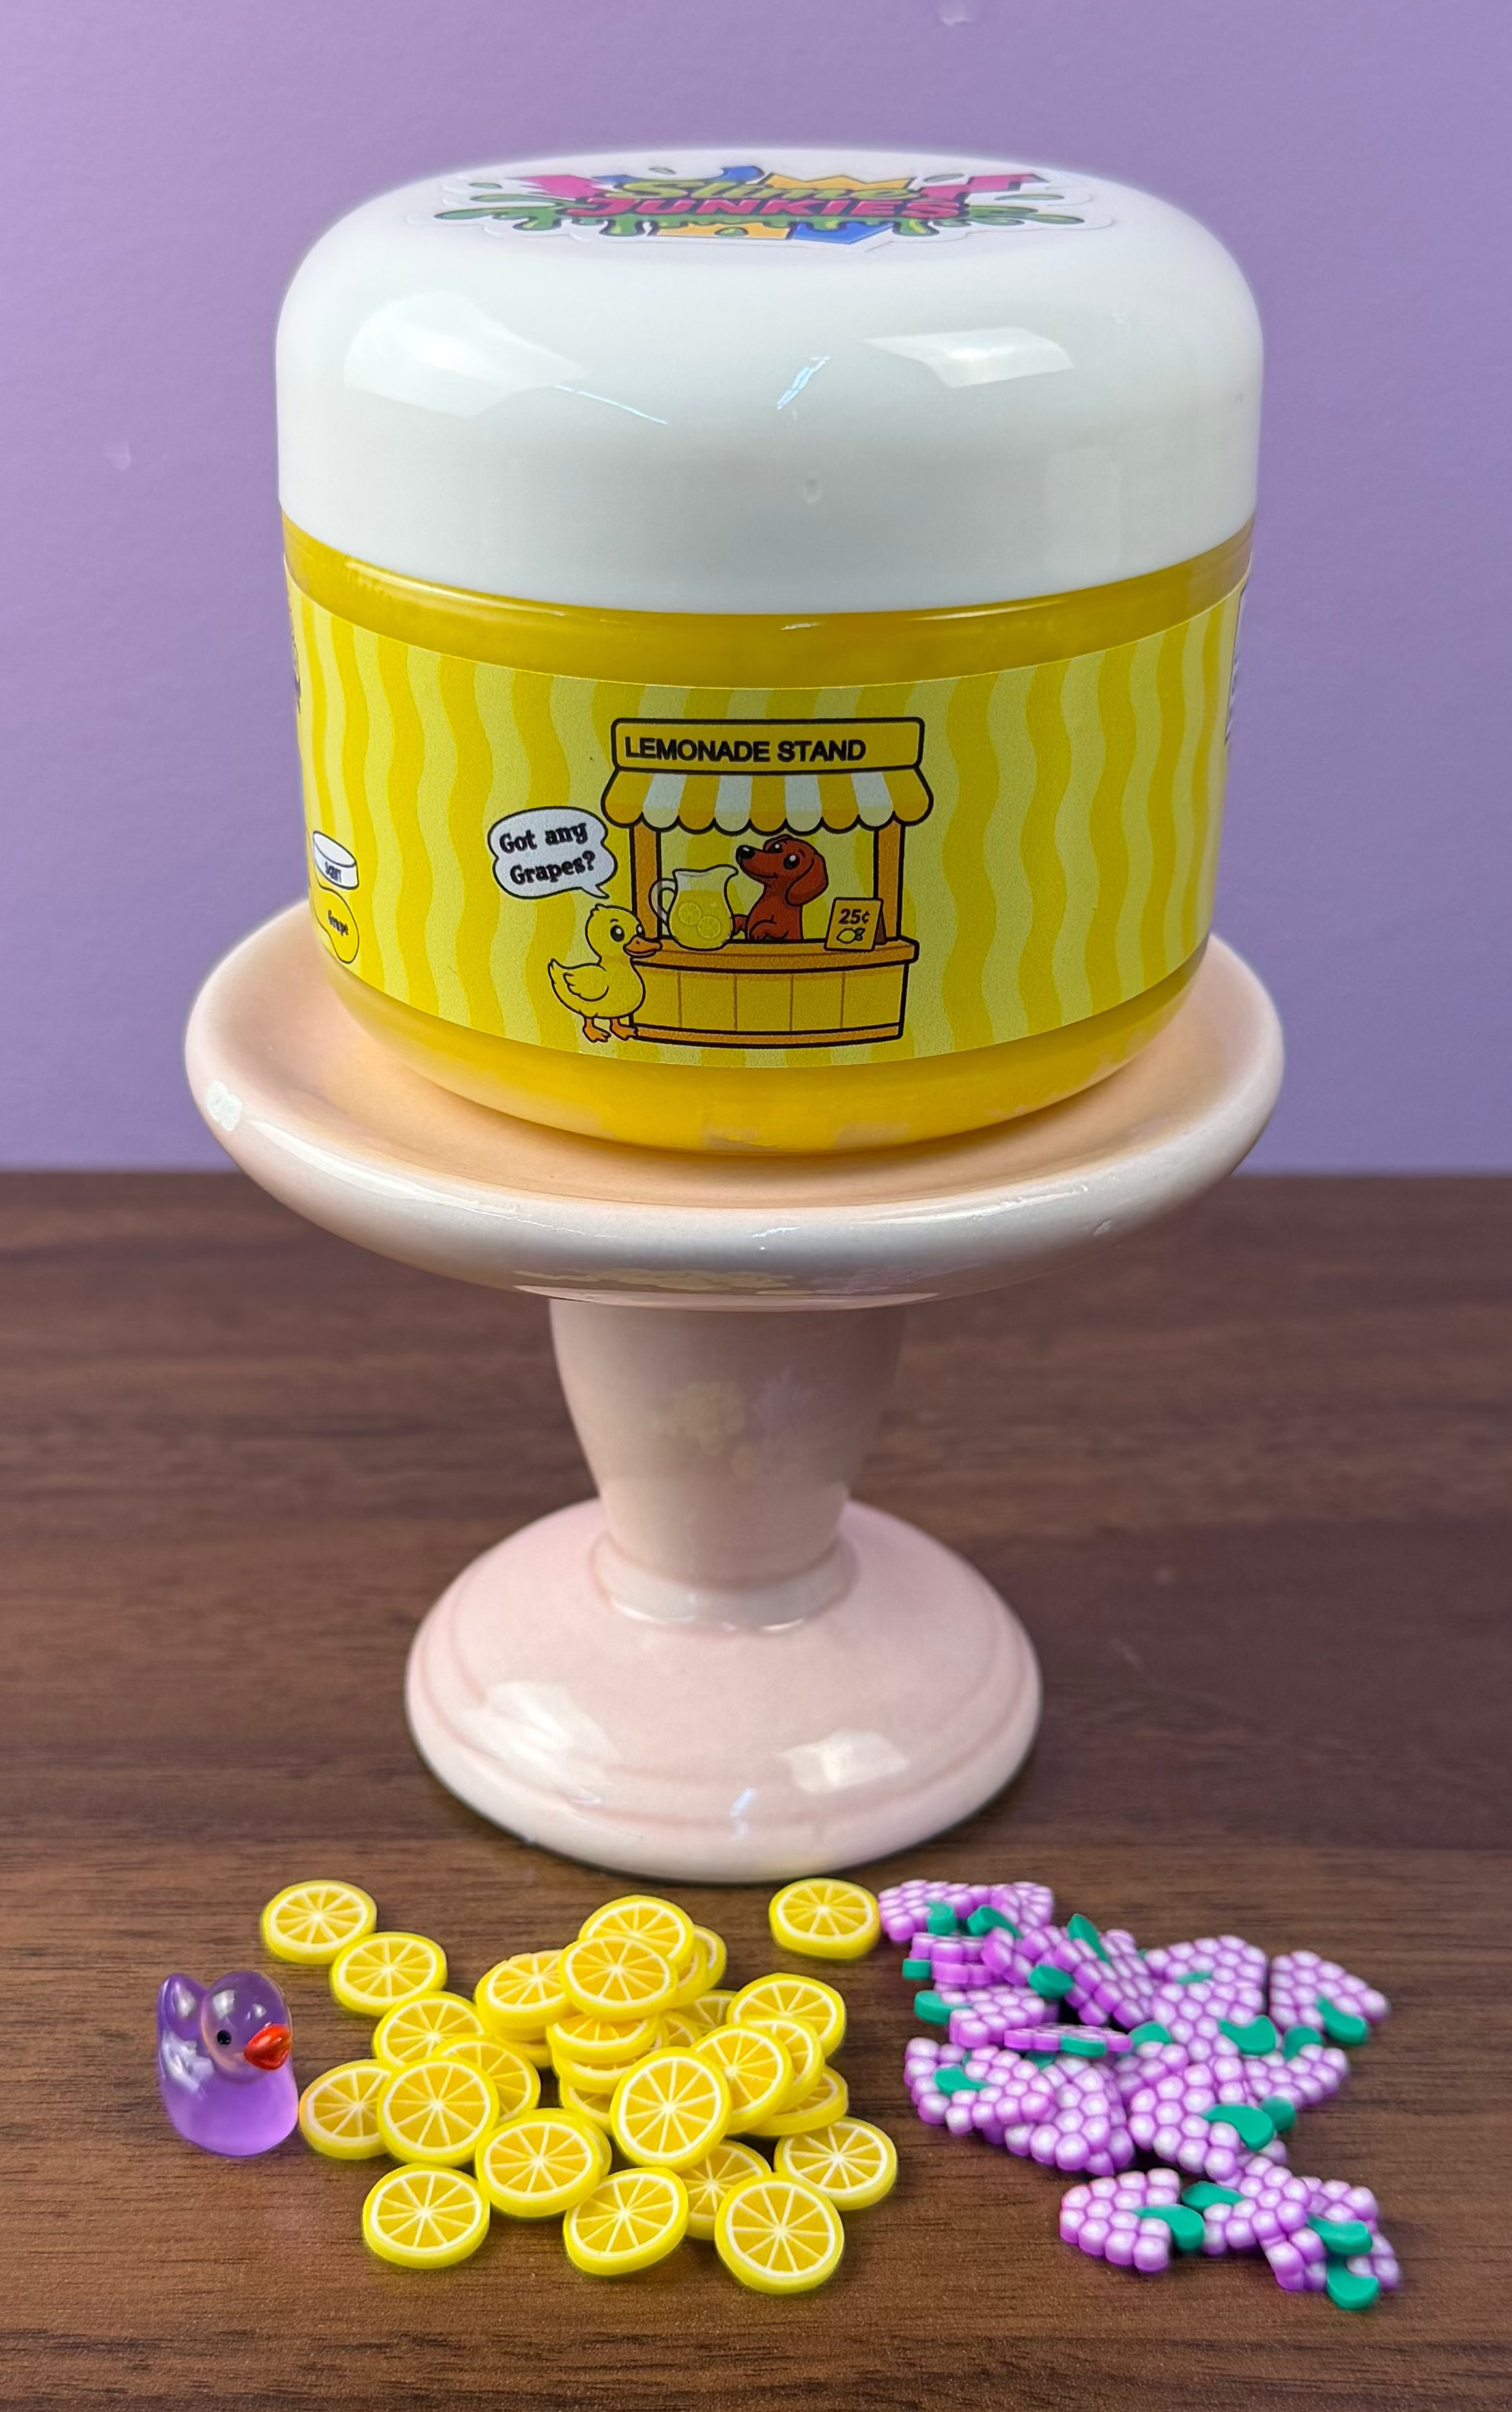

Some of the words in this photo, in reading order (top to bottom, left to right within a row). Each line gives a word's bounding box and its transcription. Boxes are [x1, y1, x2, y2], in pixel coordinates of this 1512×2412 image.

[604, 179, 919, 199] Slime
[567, 198, 962, 217] JUNKIES
[625, 736, 770, 762] LEMONADE
[777, 739, 867, 763] STAND
[499, 829, 538, 854] Got
[545, 822, 588, 845] any
[509, 850, 596, 885] Grapes?
[838, 908, 870, 925] 25¢
